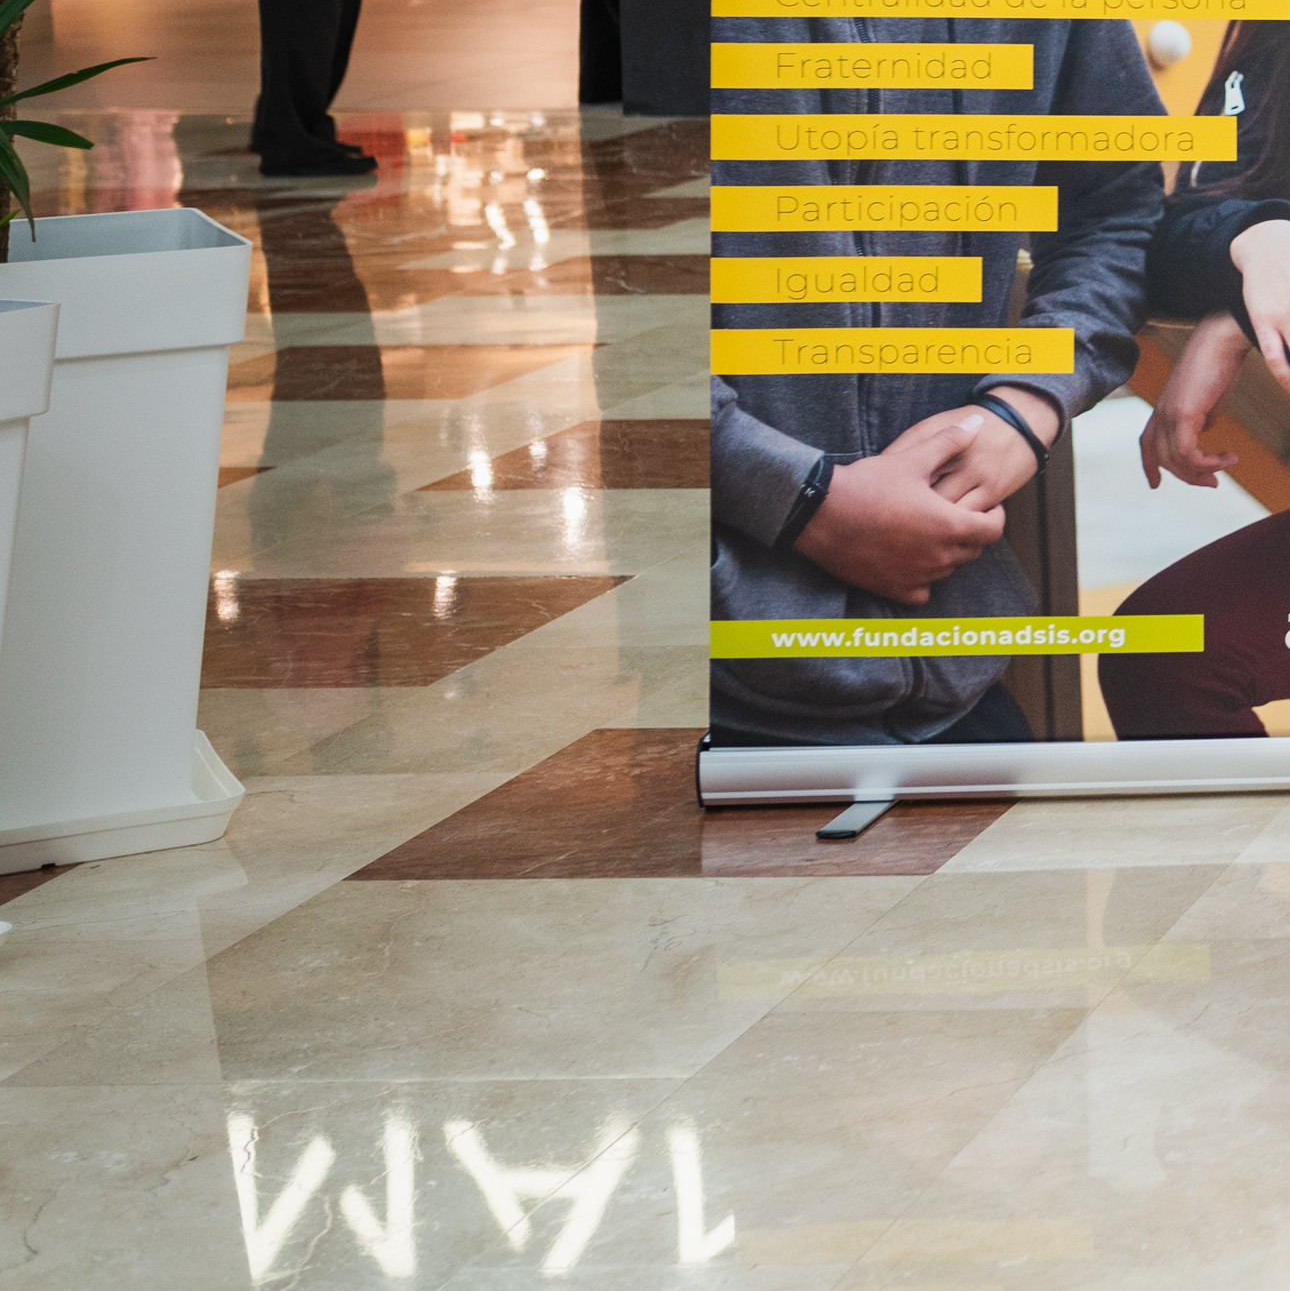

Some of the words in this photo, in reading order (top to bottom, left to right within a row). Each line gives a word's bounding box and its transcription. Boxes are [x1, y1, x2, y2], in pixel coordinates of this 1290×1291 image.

[775, 51, 993, 81] Fraternidad
[775, 122, 900, 157] Utopía
[911, 122, 1196, 153] transformadora
[775, 194, 1019, 229] Participación
[775, 265, 940, 301] Igualdad
[772, 337, 1034, 369] Transparencia
[771, 615, 1127, 650] www.fundacionadsis.org
